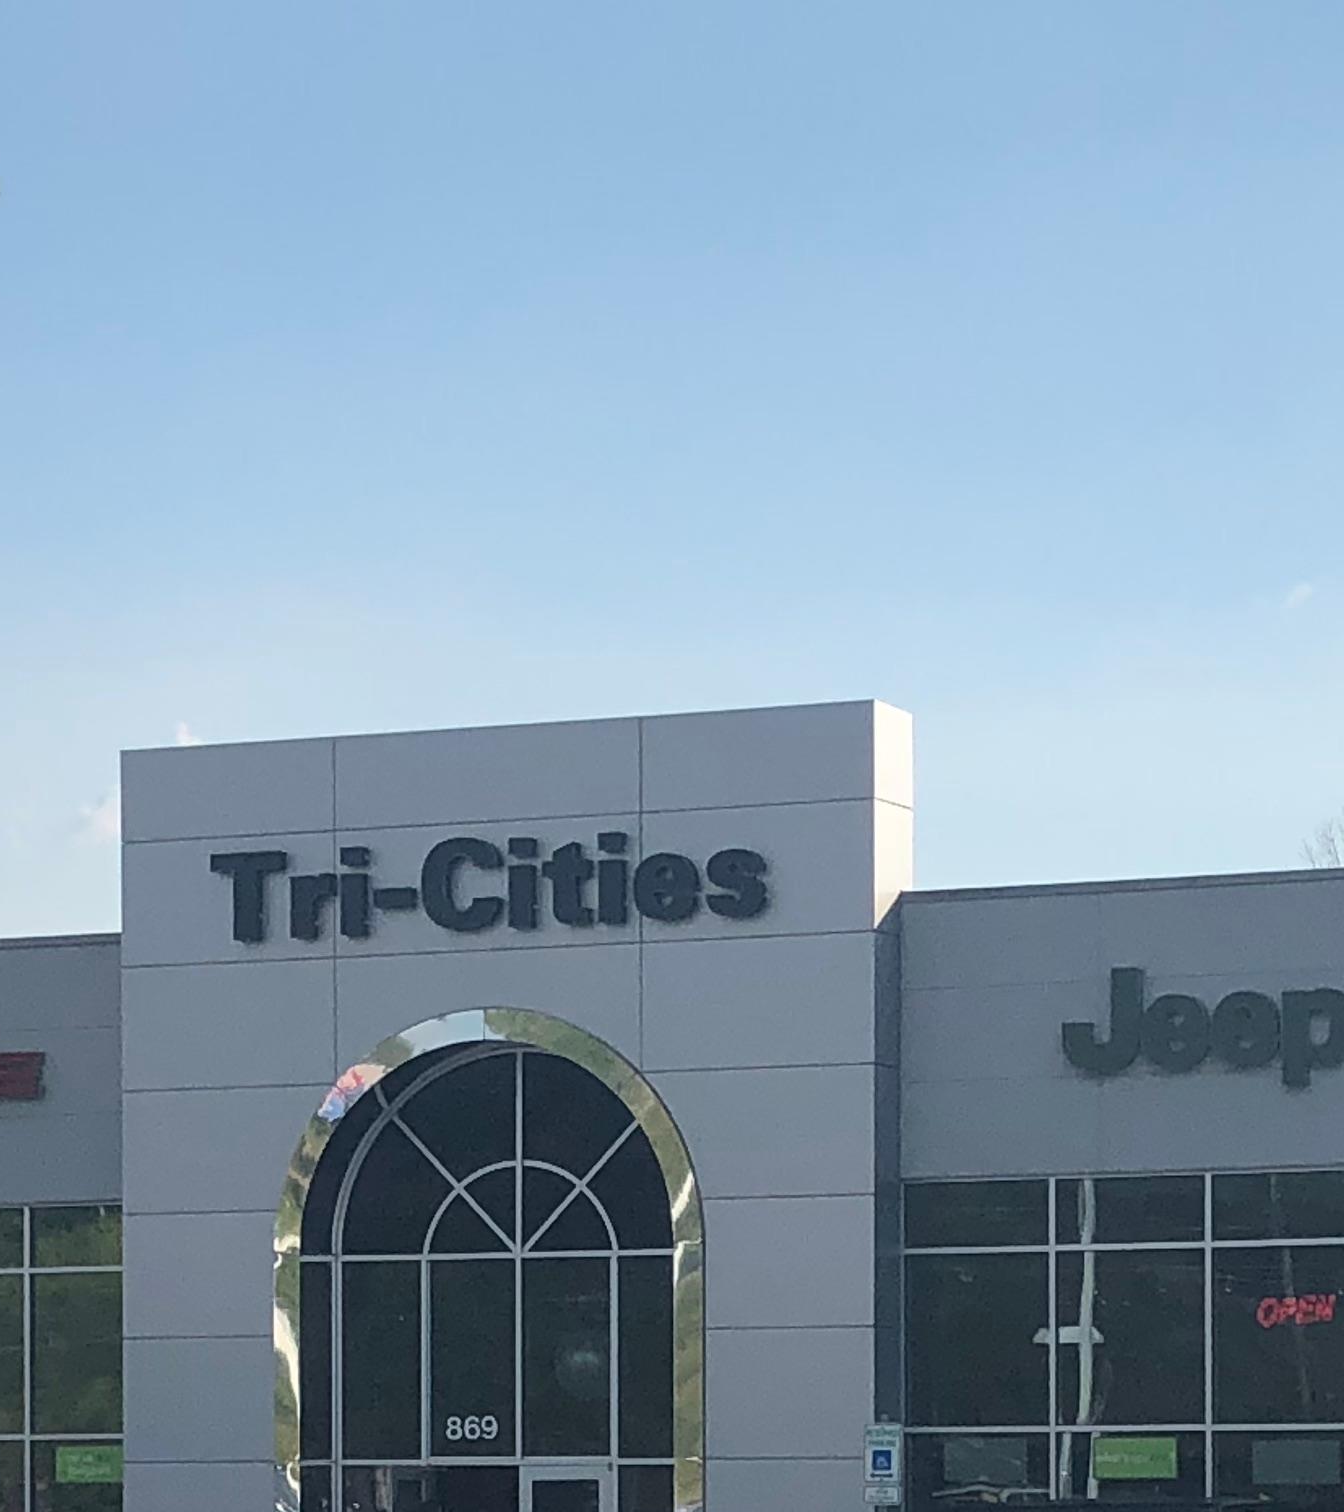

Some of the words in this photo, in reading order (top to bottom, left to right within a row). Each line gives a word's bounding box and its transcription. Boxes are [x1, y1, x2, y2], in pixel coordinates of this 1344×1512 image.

[210, 832, 768, 943] Tri-Cities
[1256, 1294, 1337, 1328] OPEN
[445, 1415, 498, 1440] 869
